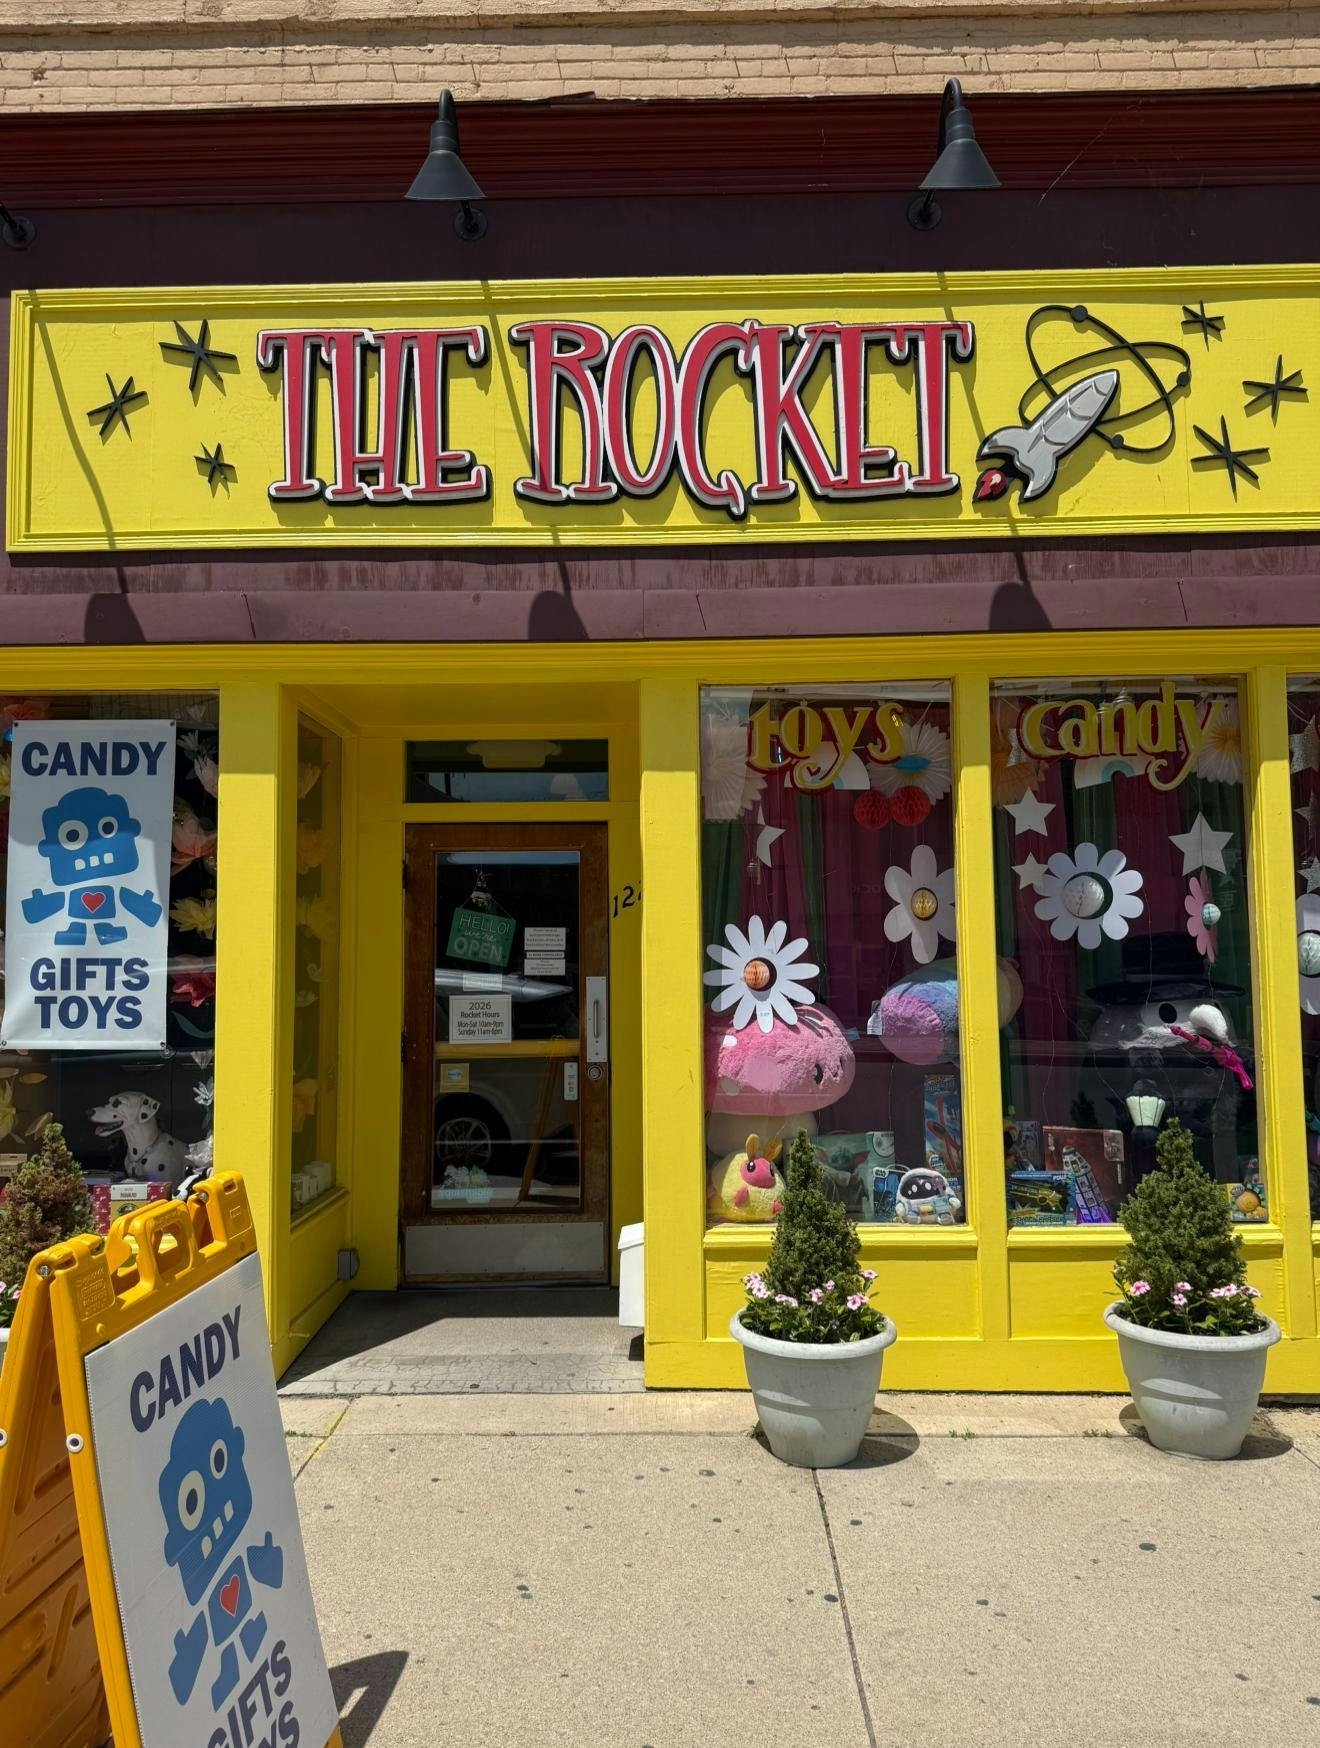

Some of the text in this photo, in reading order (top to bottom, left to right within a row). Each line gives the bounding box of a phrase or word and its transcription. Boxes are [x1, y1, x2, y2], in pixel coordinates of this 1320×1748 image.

[257, 319, 976, 521] THE ROCKET
[747, 699, 904, 791] toys
[1016, 682, 1225, 791] candy
[22, 741, 167, 777] CANDY
[613, 880, 642, 918] 12
[454, 937, 503, 961] OPEN
[29, 957, 150, 992] GIFTS
[34, 995, 143, 1030] TOYS
[469, 1001, 492, 1010] 2026
[458, 1028, 477, 1036] Sunday
[129, 1304, 242, 1433] CANDY
